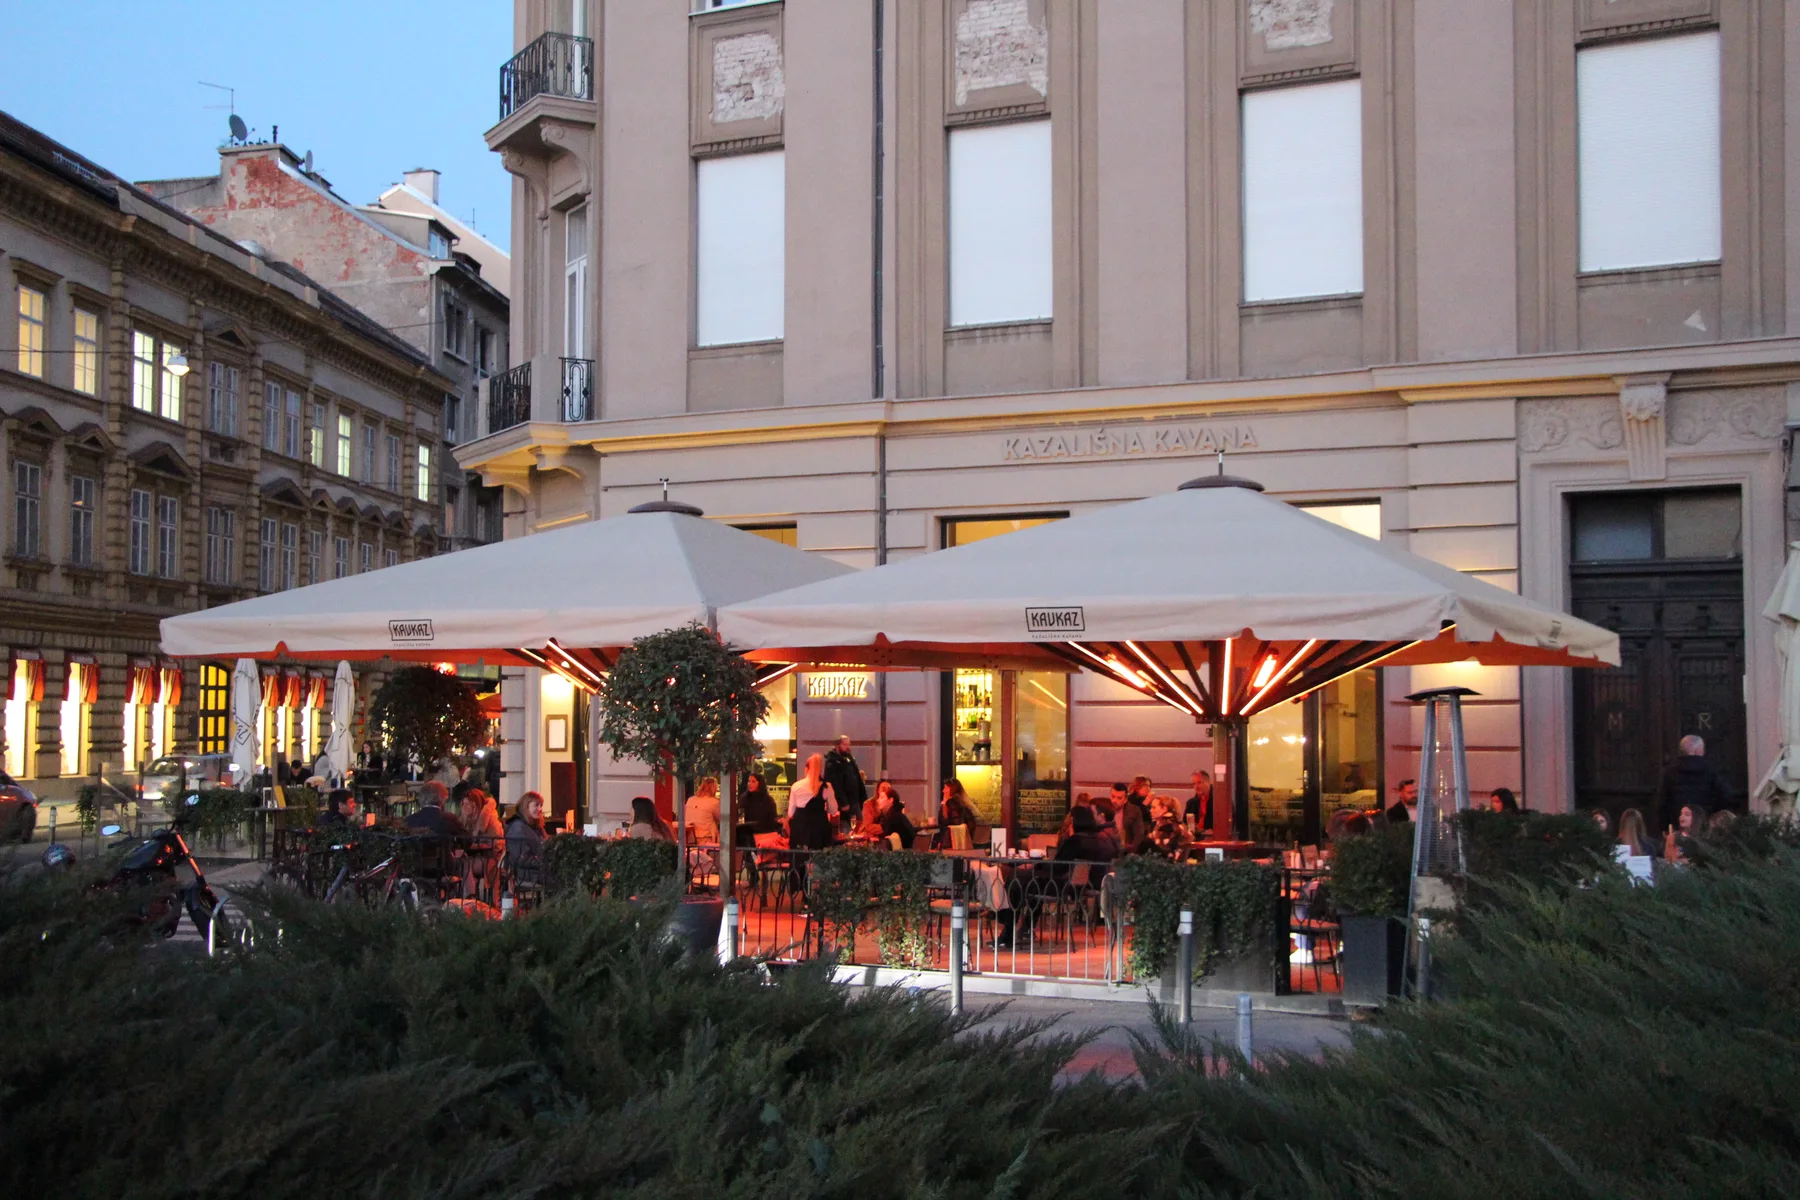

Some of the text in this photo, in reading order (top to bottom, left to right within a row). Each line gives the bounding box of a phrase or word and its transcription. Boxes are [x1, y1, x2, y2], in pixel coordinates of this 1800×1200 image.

[1153, 425, 1260, 453] KAVANA
[1031, 611, 1080, 627] KAVKAZ
[392, 623, 431, 637] KAVKAZ
[807, 676, 868, 697] KAVKAZ
